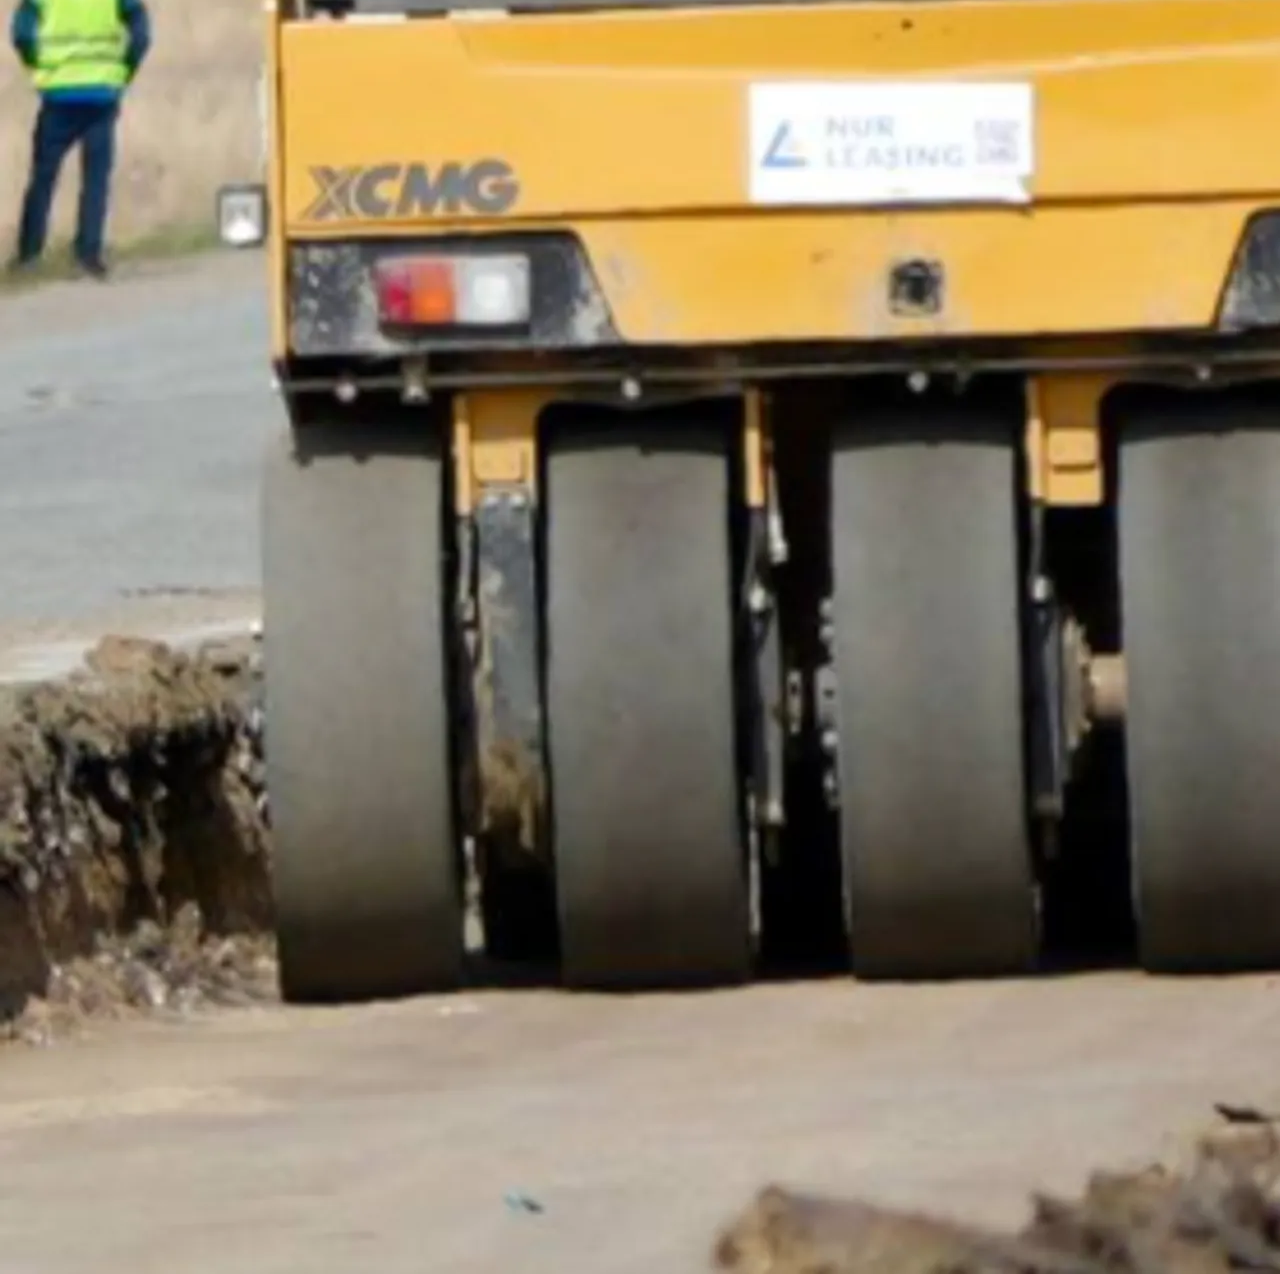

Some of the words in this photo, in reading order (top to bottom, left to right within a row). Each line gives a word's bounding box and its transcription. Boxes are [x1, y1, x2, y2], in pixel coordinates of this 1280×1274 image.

[826, 114, 895, 138] NUR
[825, 144, 966, 169] LEASING
[300, 158, 519, 221] XCMG
